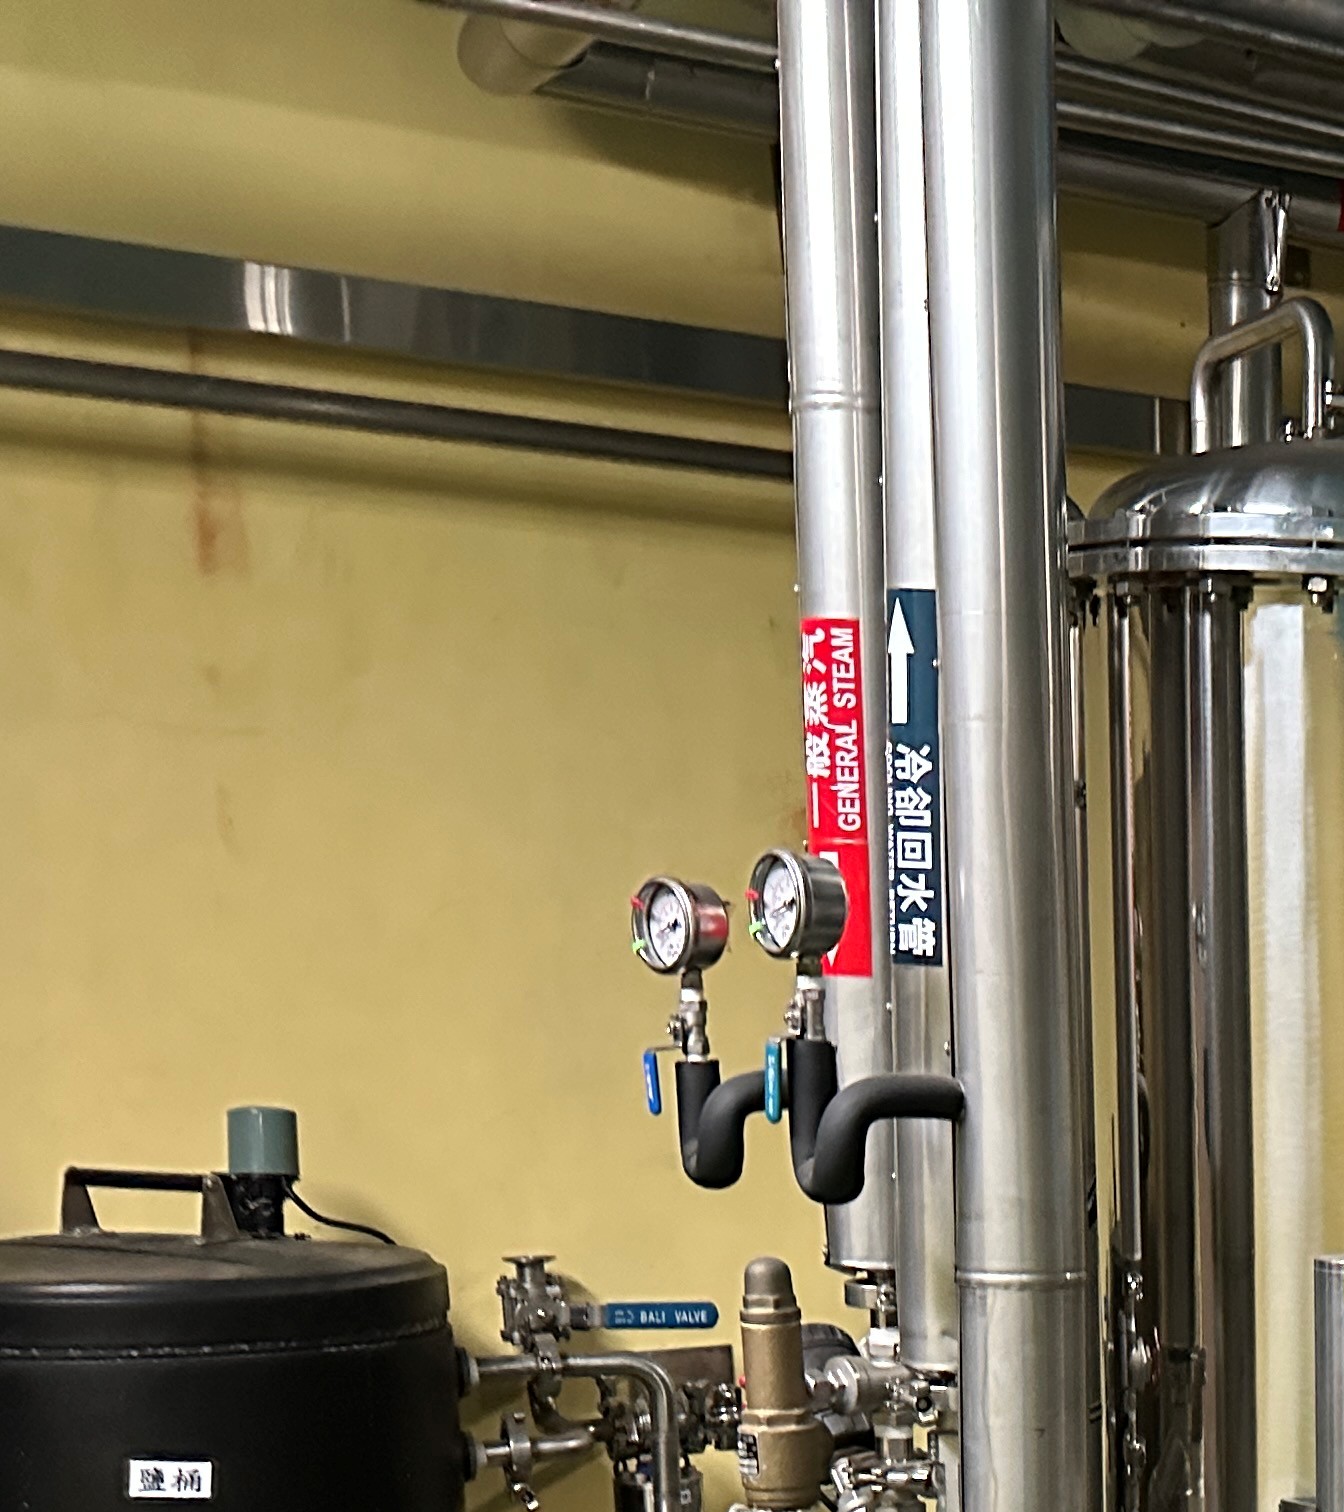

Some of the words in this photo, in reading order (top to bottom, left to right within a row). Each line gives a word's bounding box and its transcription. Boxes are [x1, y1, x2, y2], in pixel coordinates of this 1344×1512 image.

[830, 627, 857, 709] STEAM
[801, 627, 832, 829] 一般蒸汽
[835, 719, 862, 832] GENERAL
[674, 1309, 707, 1324] VALVE
